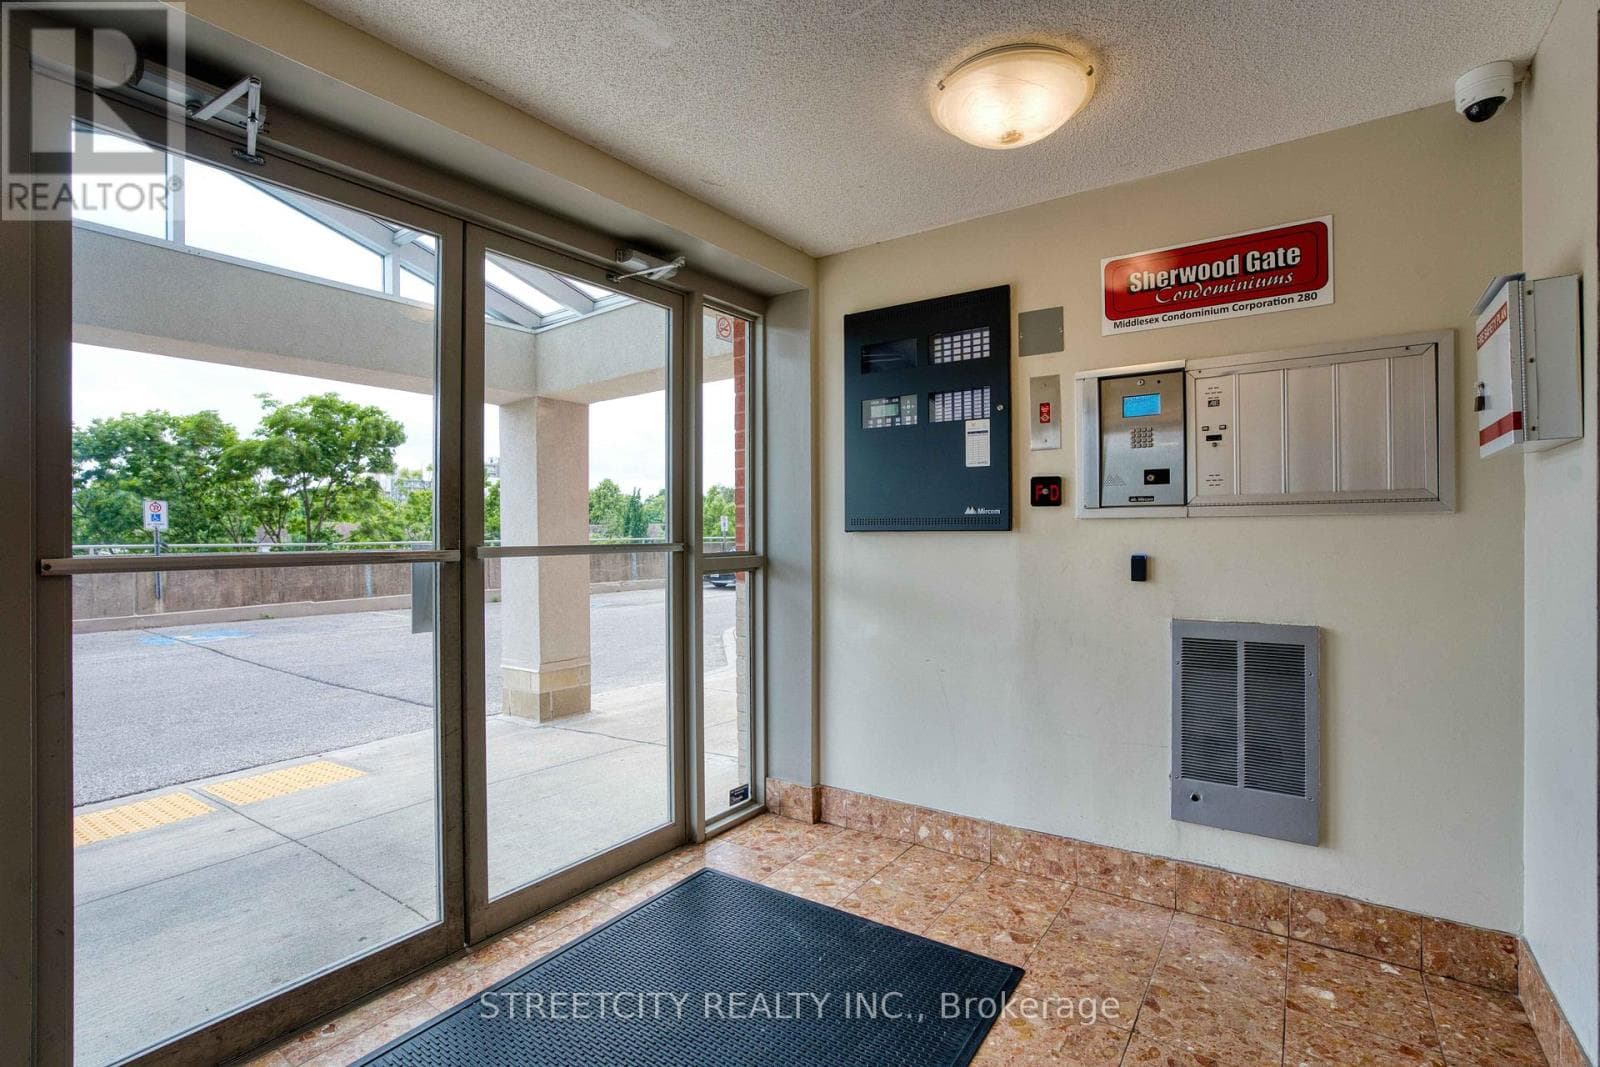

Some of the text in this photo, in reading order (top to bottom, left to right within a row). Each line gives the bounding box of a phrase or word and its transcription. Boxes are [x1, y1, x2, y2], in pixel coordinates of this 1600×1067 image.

[1129, 246, 1301, 293] Sherwood Gate
[1155, 271, 1294, 304] Condominiums
[1113, 291, 1318, 329] Middlesex Condominium Corporation 280
